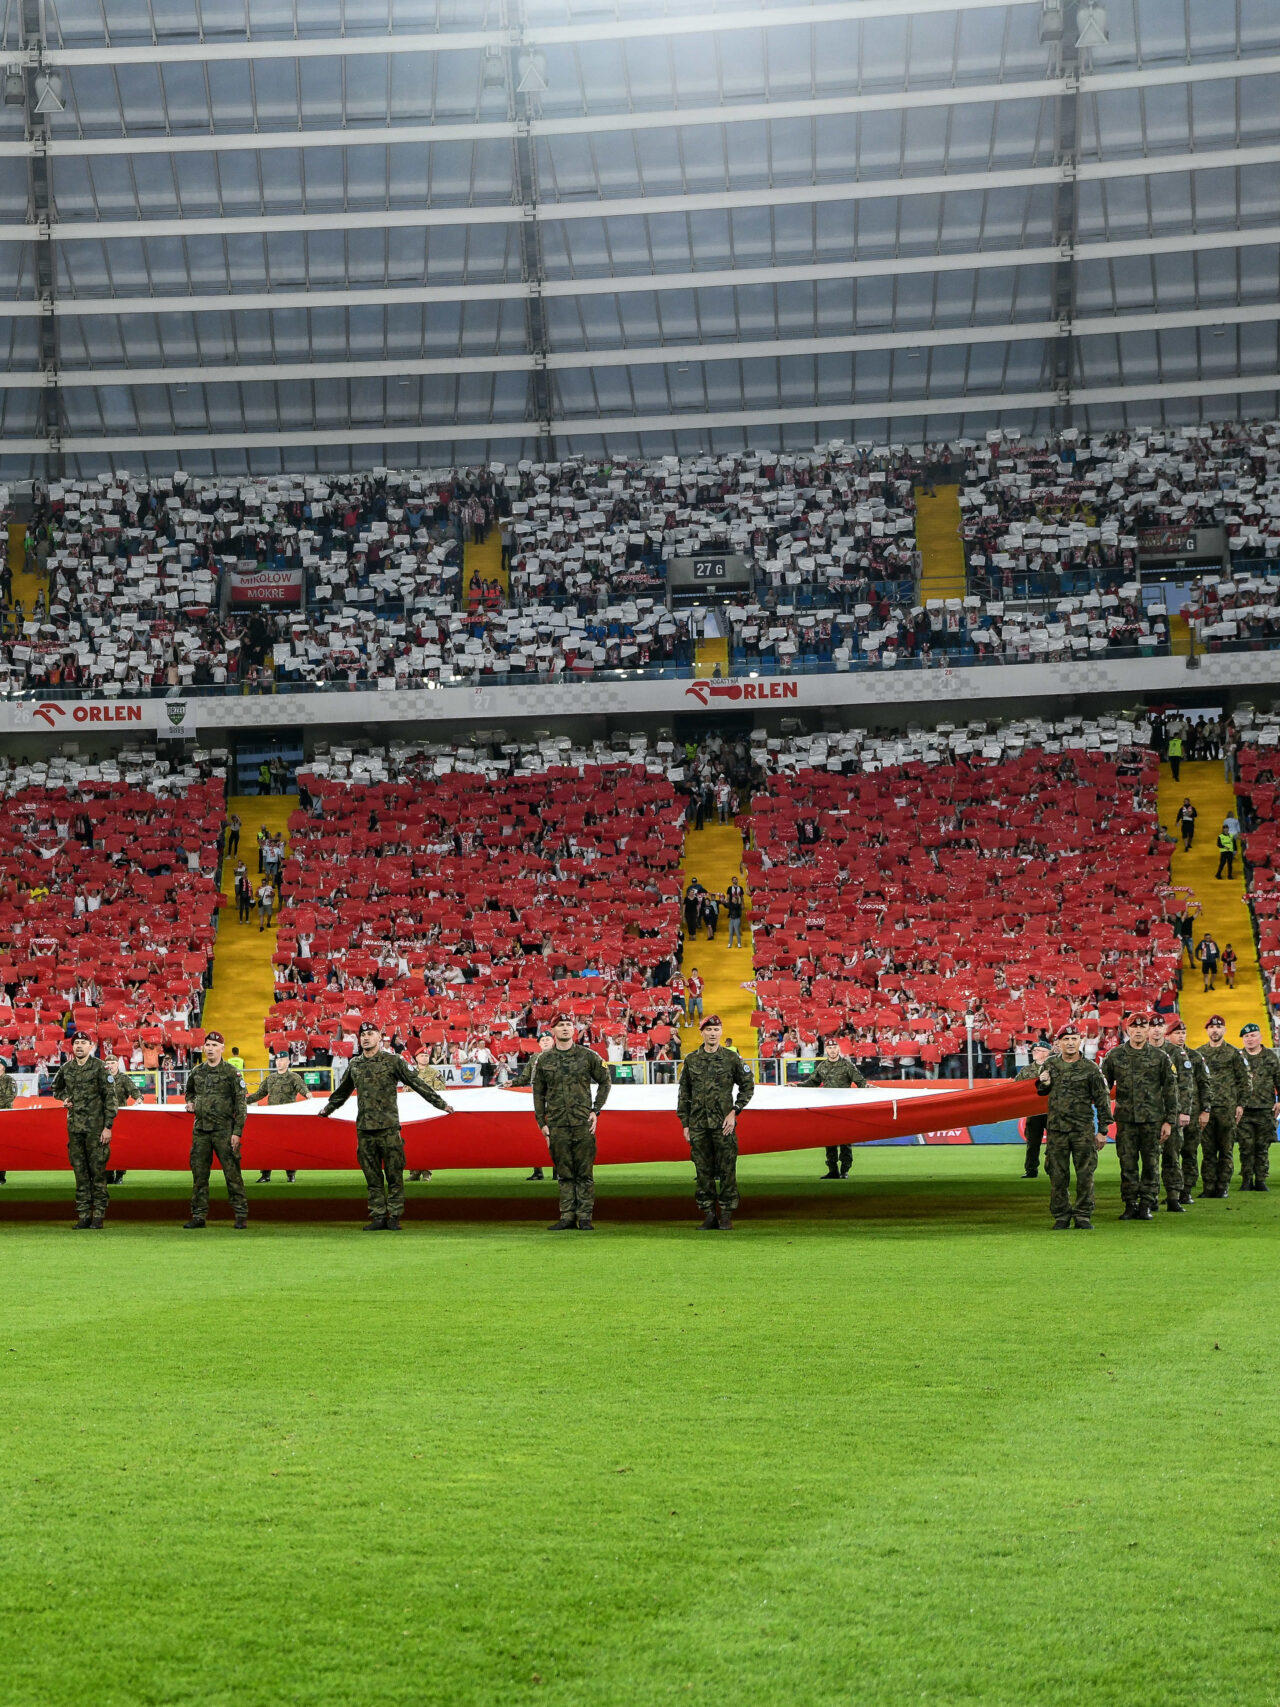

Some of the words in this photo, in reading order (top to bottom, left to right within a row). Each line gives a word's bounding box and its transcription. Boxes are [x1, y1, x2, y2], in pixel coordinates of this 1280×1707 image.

[696, 563, 712, 576] 27
[715, 564, 723, 575] G
[247, 588, 285, 598] MOKRE
[14, 710, 30, 724] 26
[72, 705, 142, 722] ORLEN
